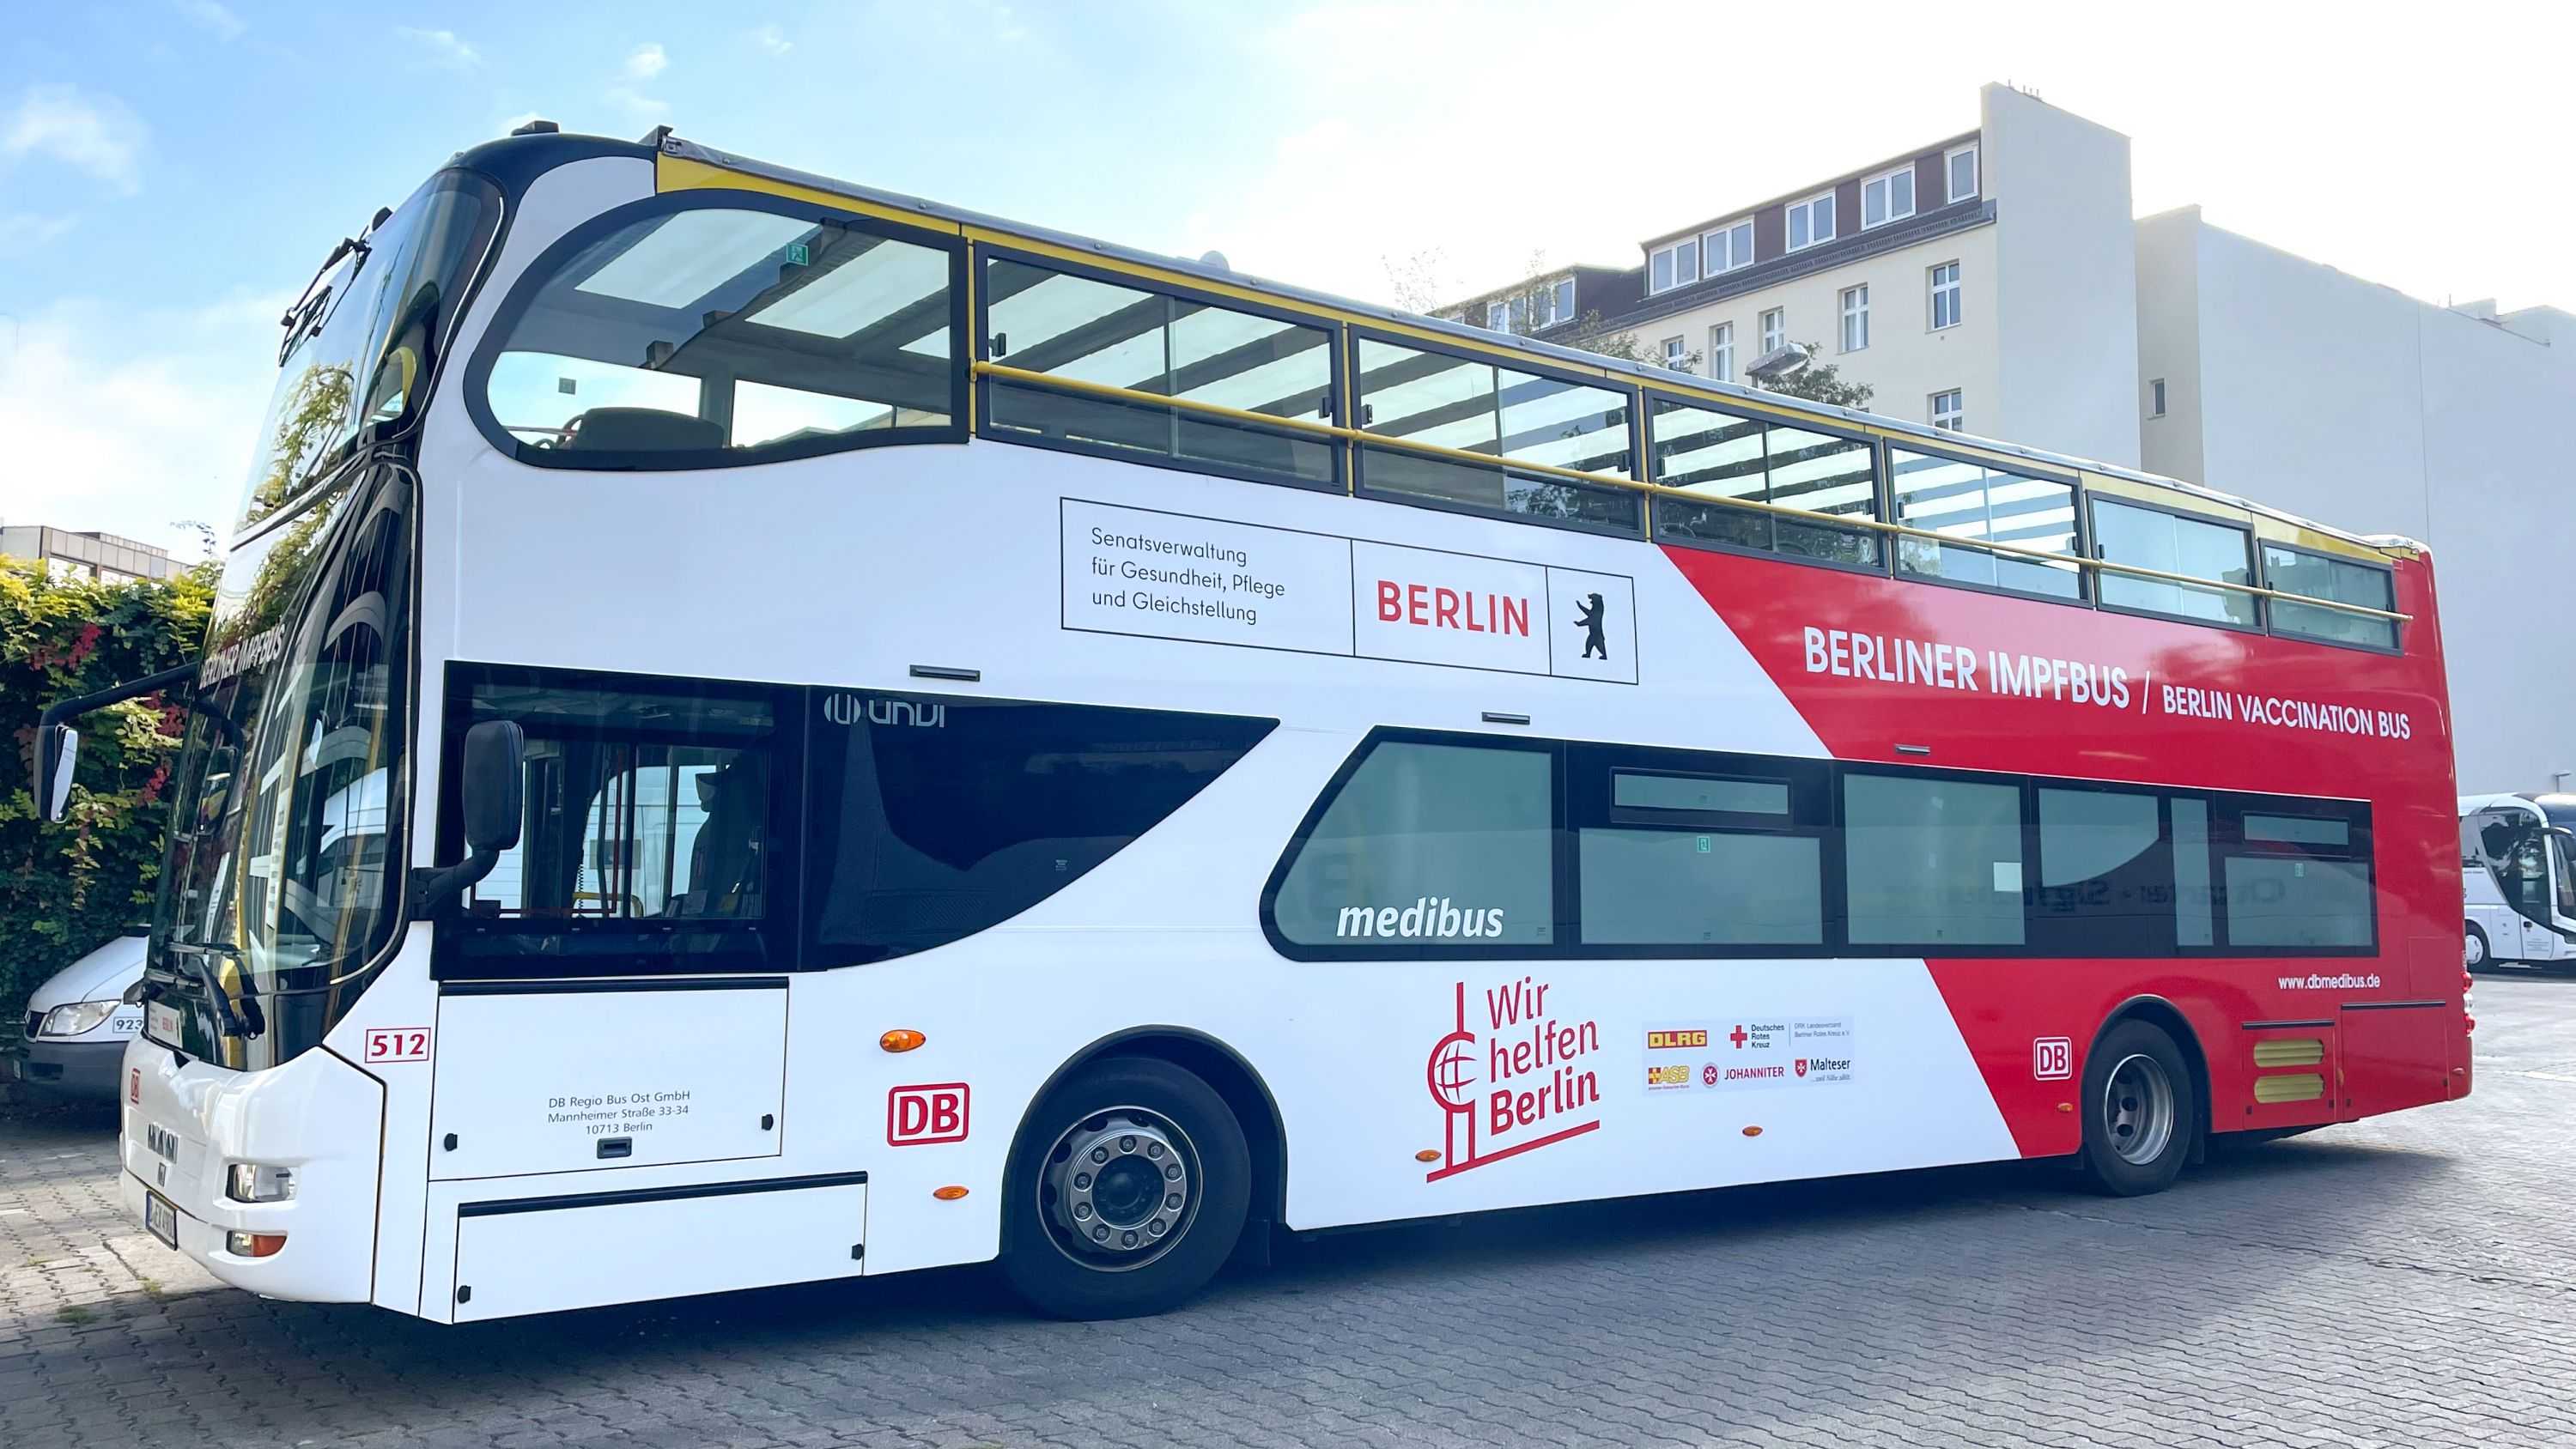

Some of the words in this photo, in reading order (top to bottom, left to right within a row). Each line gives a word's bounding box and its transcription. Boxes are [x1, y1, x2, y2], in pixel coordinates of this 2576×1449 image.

[1092, 527, 1247, 567] Senatsverwaltung
[1092, 556, 1115, 576] für
[1121, 561, 1227, 593] Gesundheit,
[1232, 574, 1285, 599] Pflege
[1092, 590, 1126, 607] und
[1133, 591, 1257, 626] Gleichstellung
[1376, 579, 1529, 638] BERLIN
[1804, 626, 1978, 692] BERLINER
[1989, 650, 2130, 710] IMPFBUS
[2141, 669, 2151, 715] /
[2162, 684, 2233, 721] BERLIN
[2236, 694, 2375, 736] VACCINATION
[2379, 709, 2412, 741] BUS
[1336, 897, 1504, 938] medibus
[2278, 973, 2381, 990] www.dbmedibus.de
[1487, 975, 1549, 1030] Wir
[1649, 1032, 1707, 1047] DLRG
[1751, 1023, 1785, 1033] Deutsches
[1751, 1032, 1771, 1040] Rotes
[371, 1033, 426, 1058] 512
[1490, 1018, 1600, 1084] helfen
[2038, 1044, 2069, 1072] DB
[1659, 1065, 1690, 1083] ASB
[1724, 1066, 1784, 1081] JOHANNITER
[1810, 1057, 1851, 1071] Malteser
[549, 1097, 566, 1108] DB
[570, 1094, 603, 1109] Regio
[607, 1094, 627, 1105] Bus
[631, 1093, 650, 1103] Ost
[654, 1090, 690, 1102] GmbH
[1491, 1070, 1600, 1136] Berlin
[548, 1111, 617, 1124] Mannheimer
[622, 1107, 655, 1119] Straße
[659, 1105, 690, 1116] 33-34
[586, 1124, 619, 1135] 10713
[623, 1122, 653, 1132] Berlin
[896, 1092, 961, 1137] DB
[147, 1123, 179, 1165] MAN
